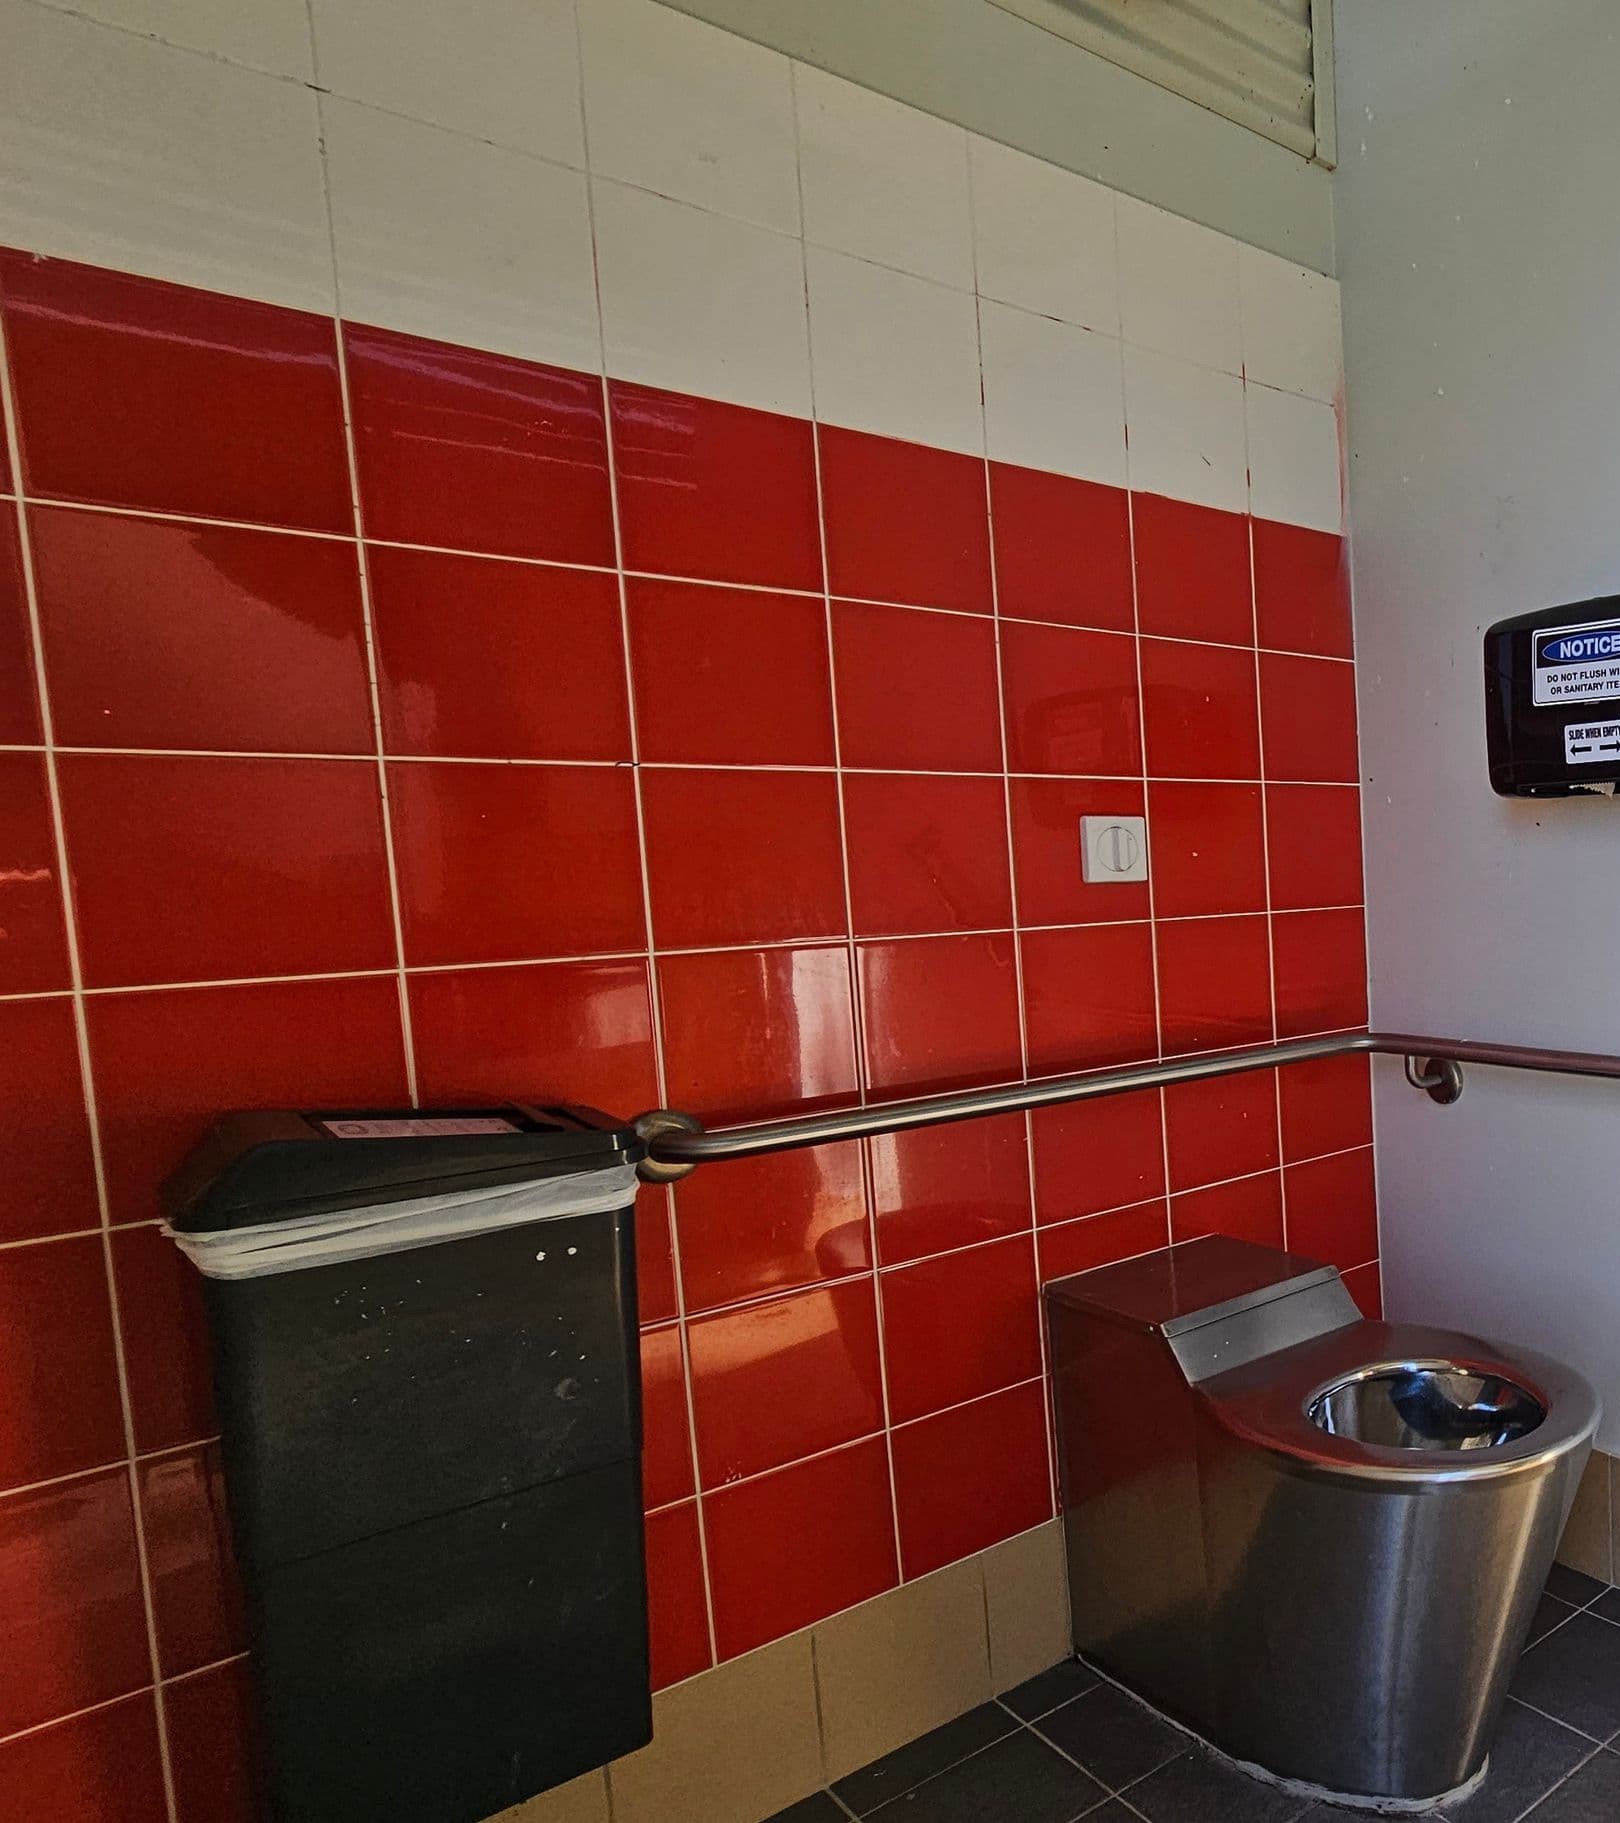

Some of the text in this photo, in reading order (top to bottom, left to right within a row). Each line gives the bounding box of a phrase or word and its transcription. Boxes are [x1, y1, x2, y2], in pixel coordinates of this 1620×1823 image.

[1547, 674, 1559, 684] DO
[1560, 672, 1578, 682] NOT
[1580, 669, 1607, 679] FLUSH
[1550, 687, 1562, 695] OR
[1564, 683, 1604, 694] SANITARY
[1568, 729, 1584, 741] SLIDE
[1585, 726, 1602, 739] WHEN
